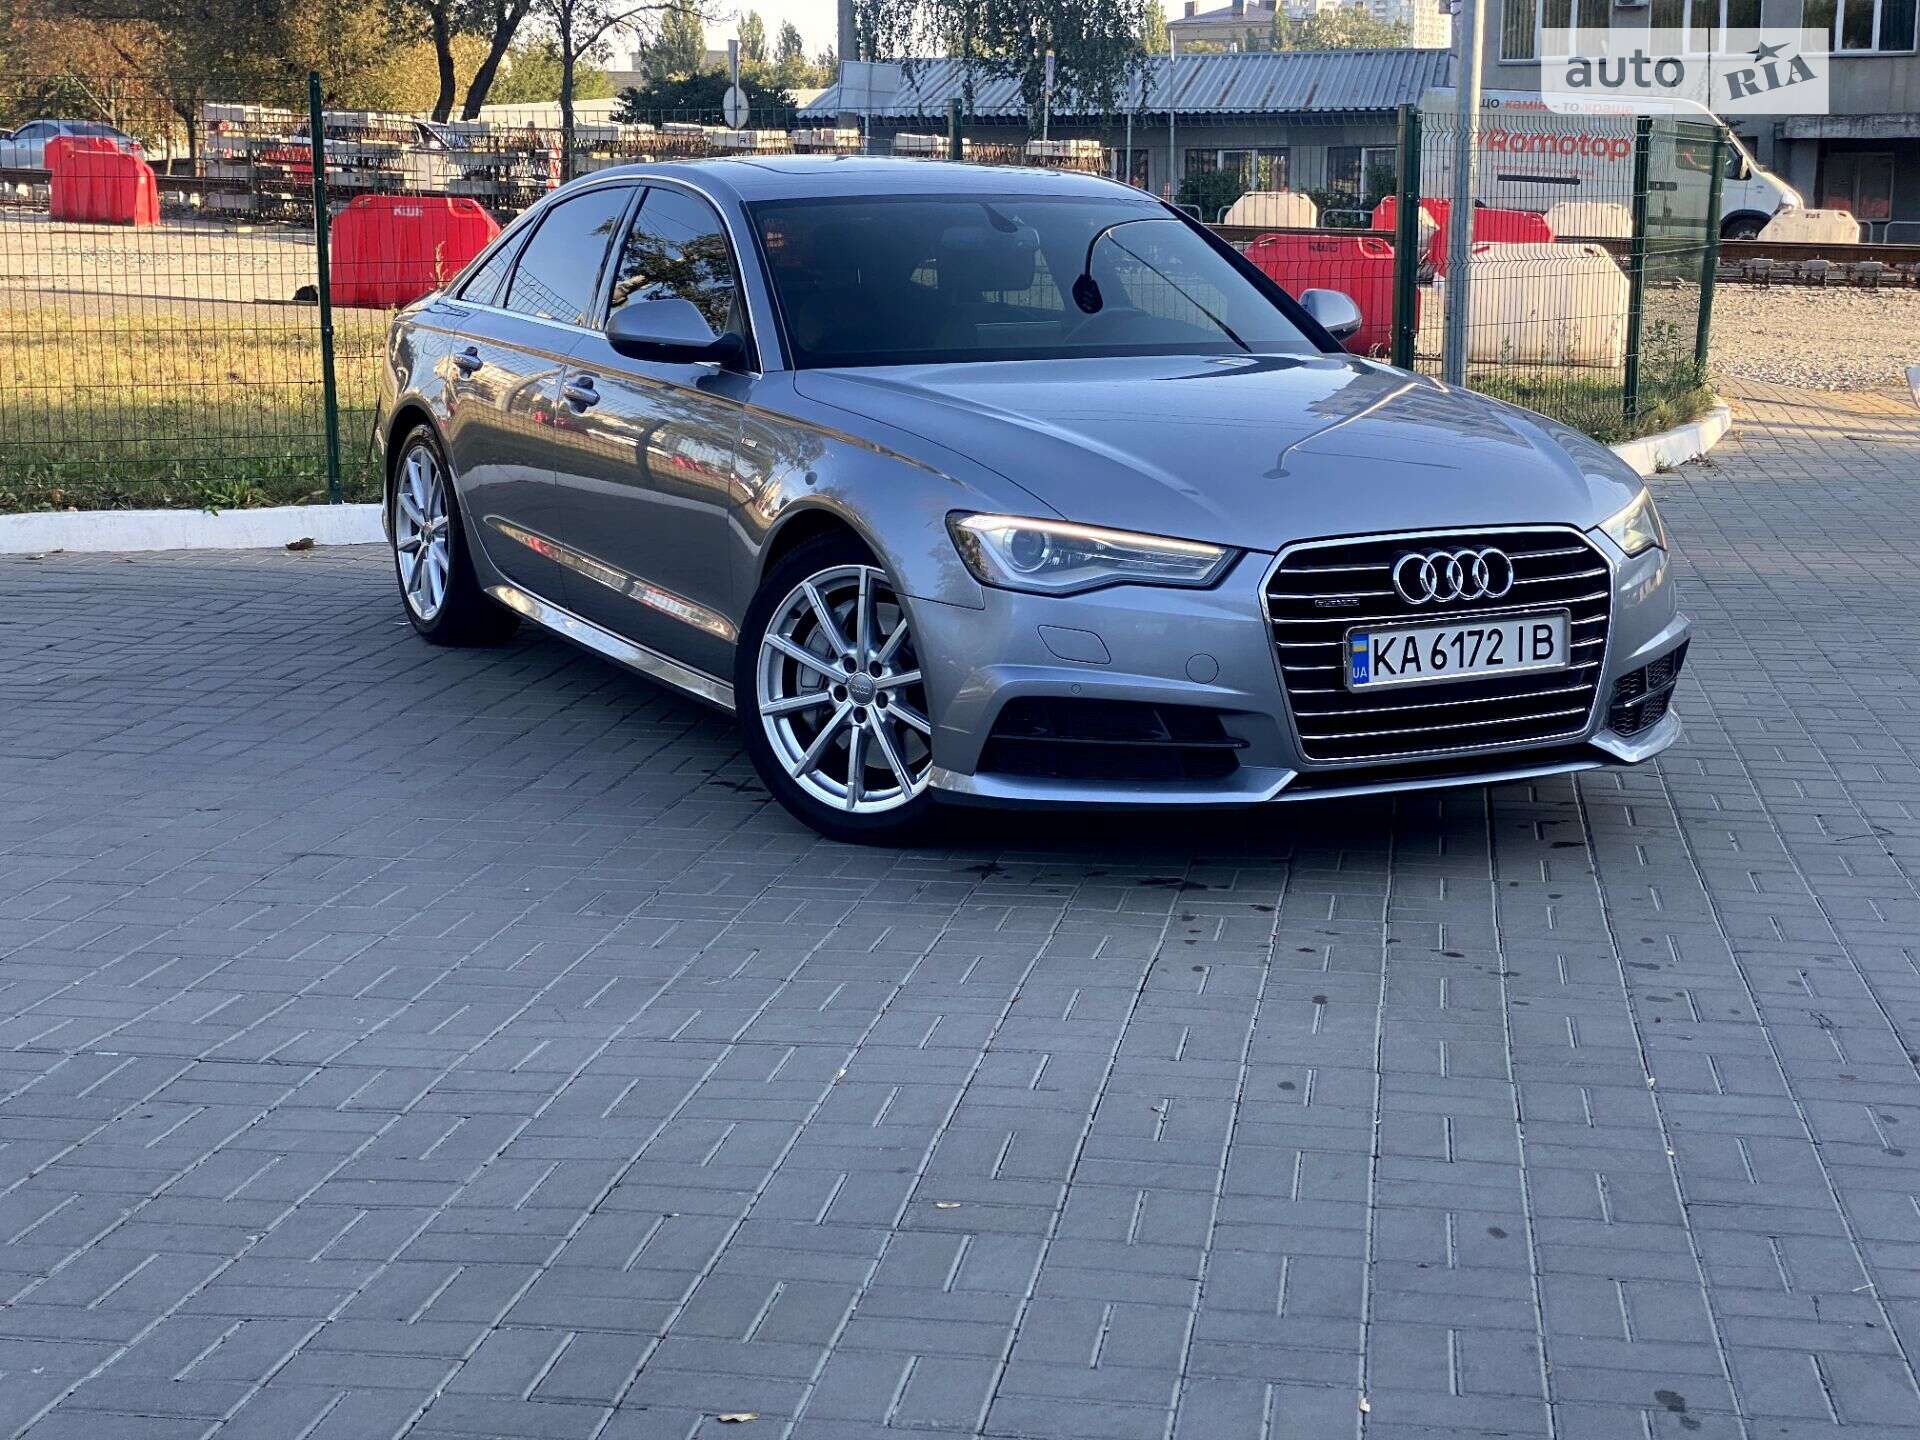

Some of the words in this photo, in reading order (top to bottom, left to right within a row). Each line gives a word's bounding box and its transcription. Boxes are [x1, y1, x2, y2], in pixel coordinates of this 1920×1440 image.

[1373, 635, 1422, 676] KA
[1430, 628, 1504, 670] 6172
[1517, 624, 1555, 662] IB
[1352, 666, 1368, 679] UA
